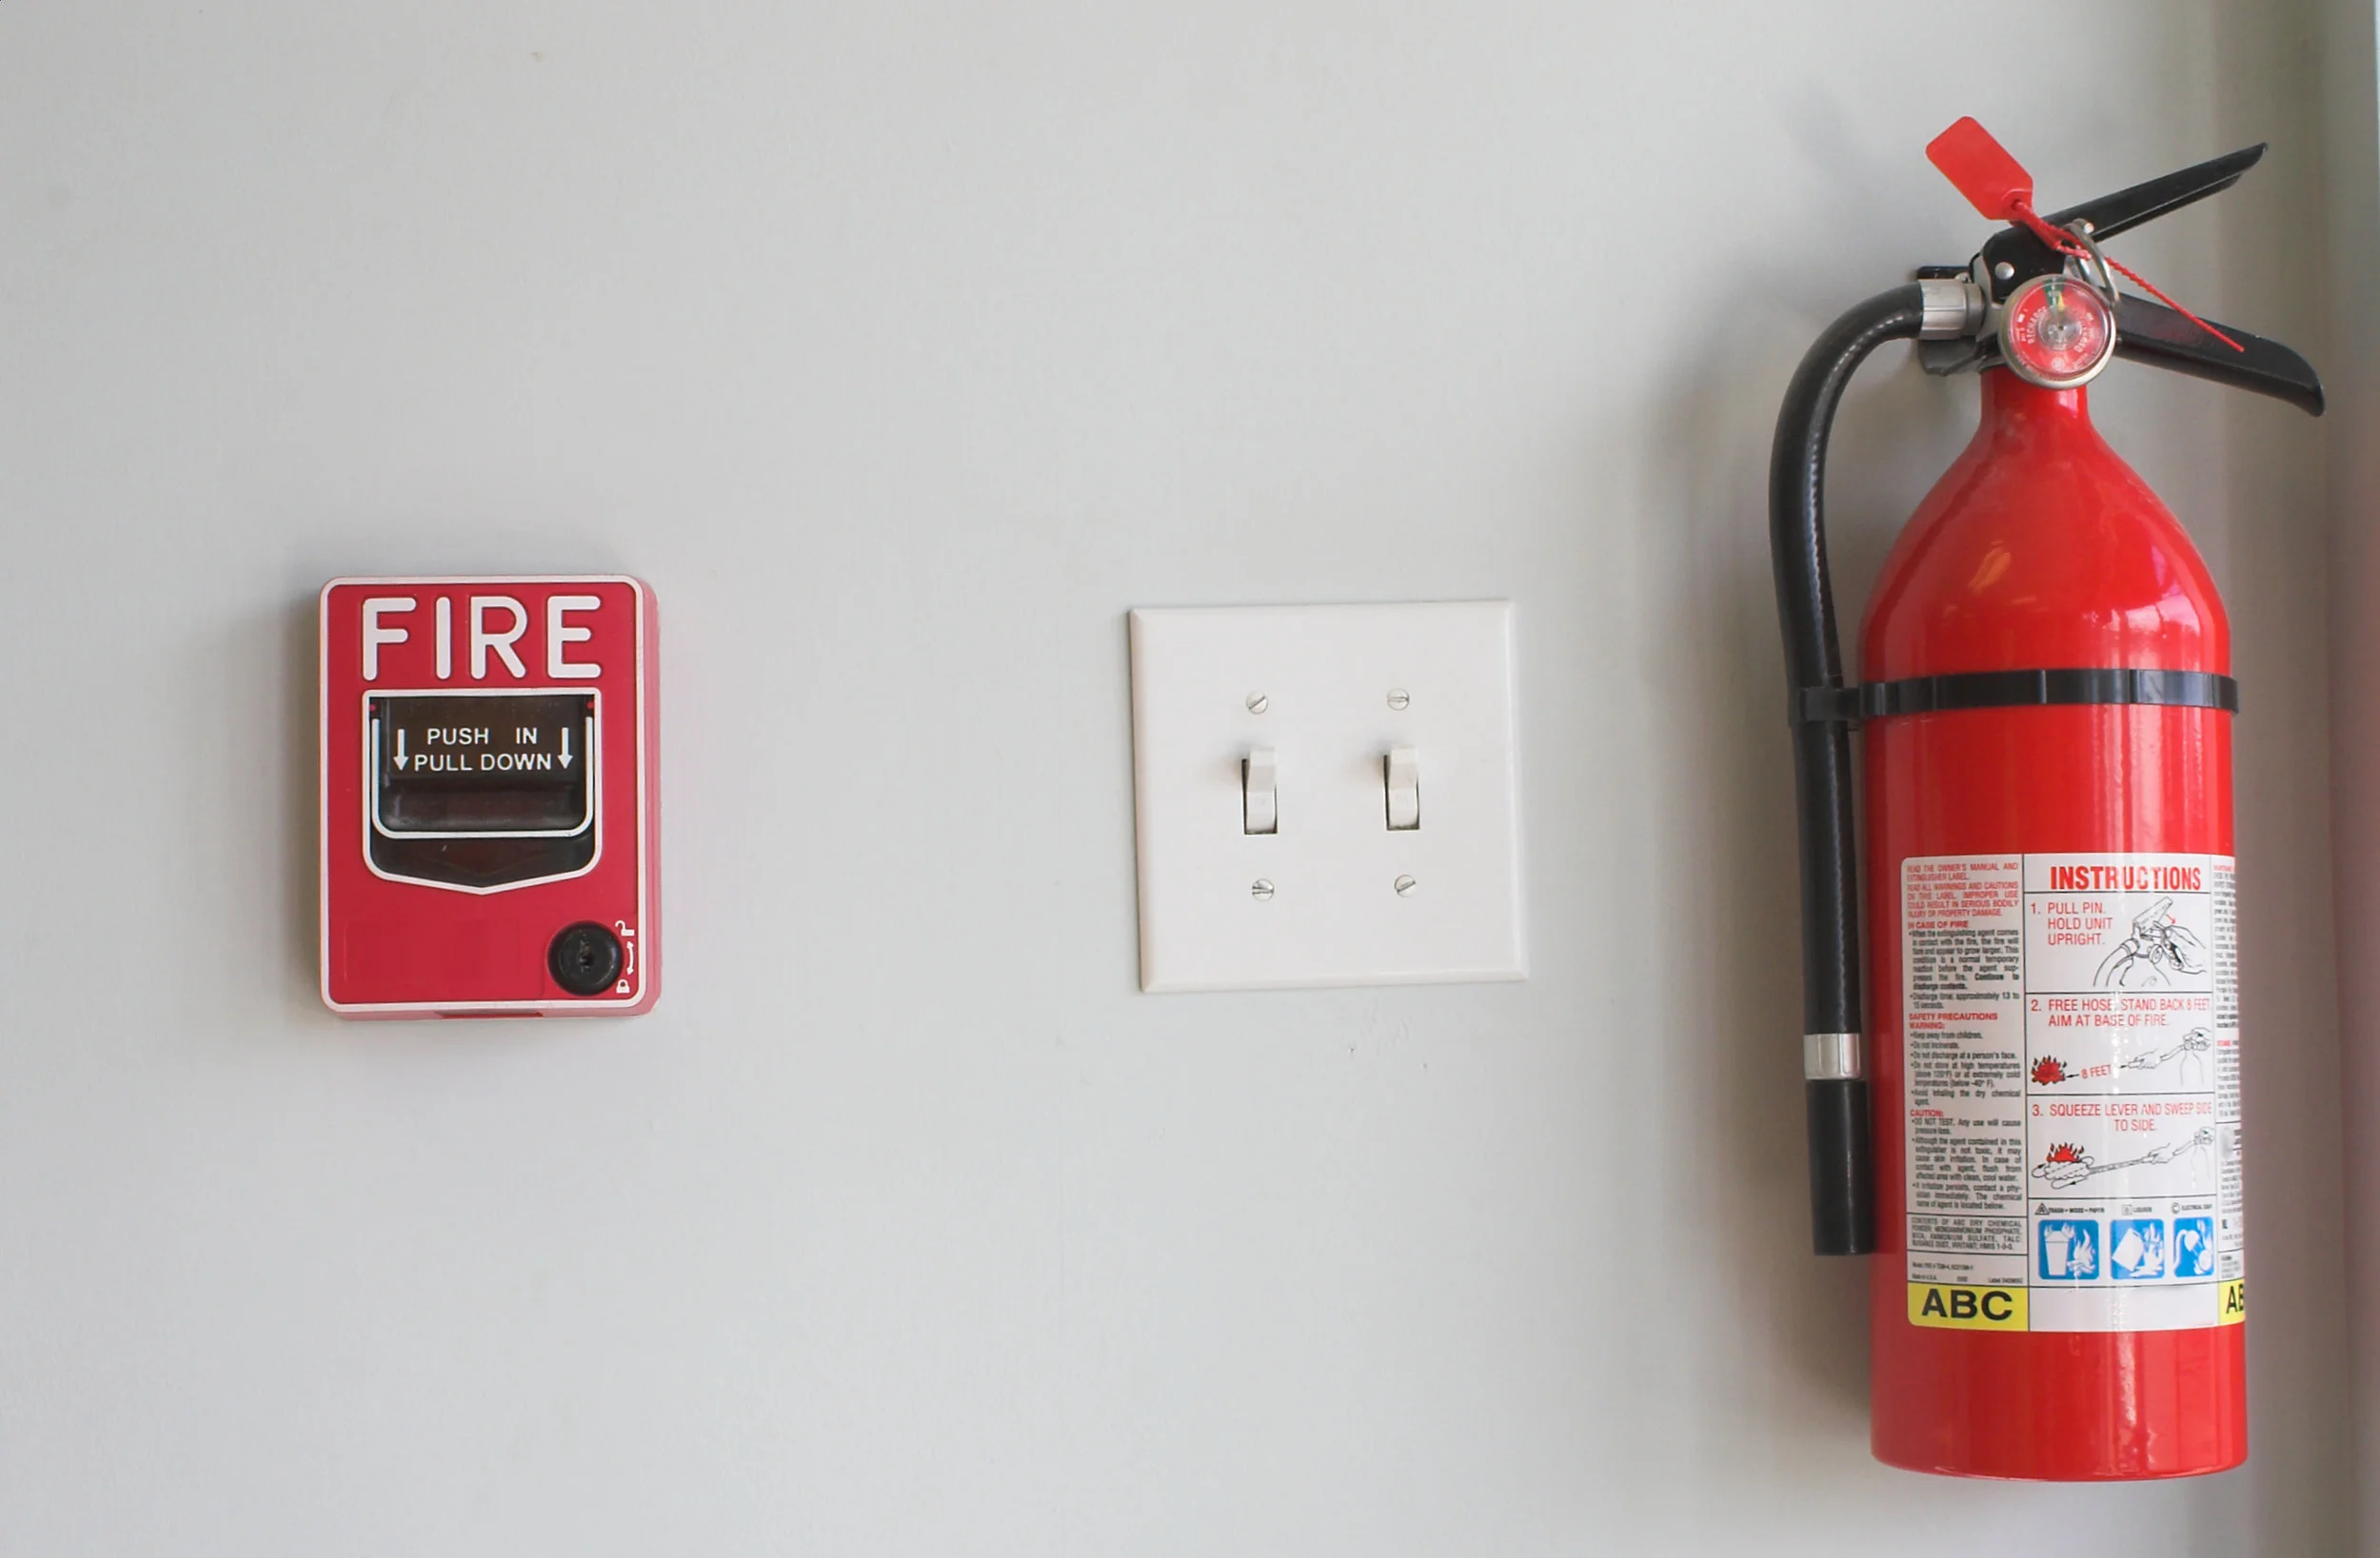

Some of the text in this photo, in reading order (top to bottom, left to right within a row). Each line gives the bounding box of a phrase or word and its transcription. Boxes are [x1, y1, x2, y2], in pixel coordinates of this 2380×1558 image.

[363, 596, 601, 680] FIRE
[427, 727, 537, 745] PUSH IN
[414, 753, 551, 771] PULL DOWN
[2051, 866, 2201, 890] INSTRUCTIONS
[2031, 902, 2106, 915] 1. PULL PIN.
[2048, 917, 2112, 930] HOLD UNIT
[2048, 933, 2105, 945] UPRIGHT.
[2031, 1000, 2041, 1012] 2.
[2049, 999, 2077, 1011] FREE
[2122, 999, 2156, 1011] STAND
[2160, 999, 2183, 1010] BACK
[2049, 1015, 2072, 1026] AIM
[2075, 1015, 2091, 1026] AT
[2095, 1015, 2124, 1026] BASE
[2128, 1015, 2142, 1026] OF
[2091, 1065, 2111, 1077] FEET
[2033, 1102, 2211, 1116] 3. SQUEEZE LEVER AND SWEEP SIDE
[2114, 1119, 2128, 1131] TO
[1921, 1288, 2013, 1321] ABC
